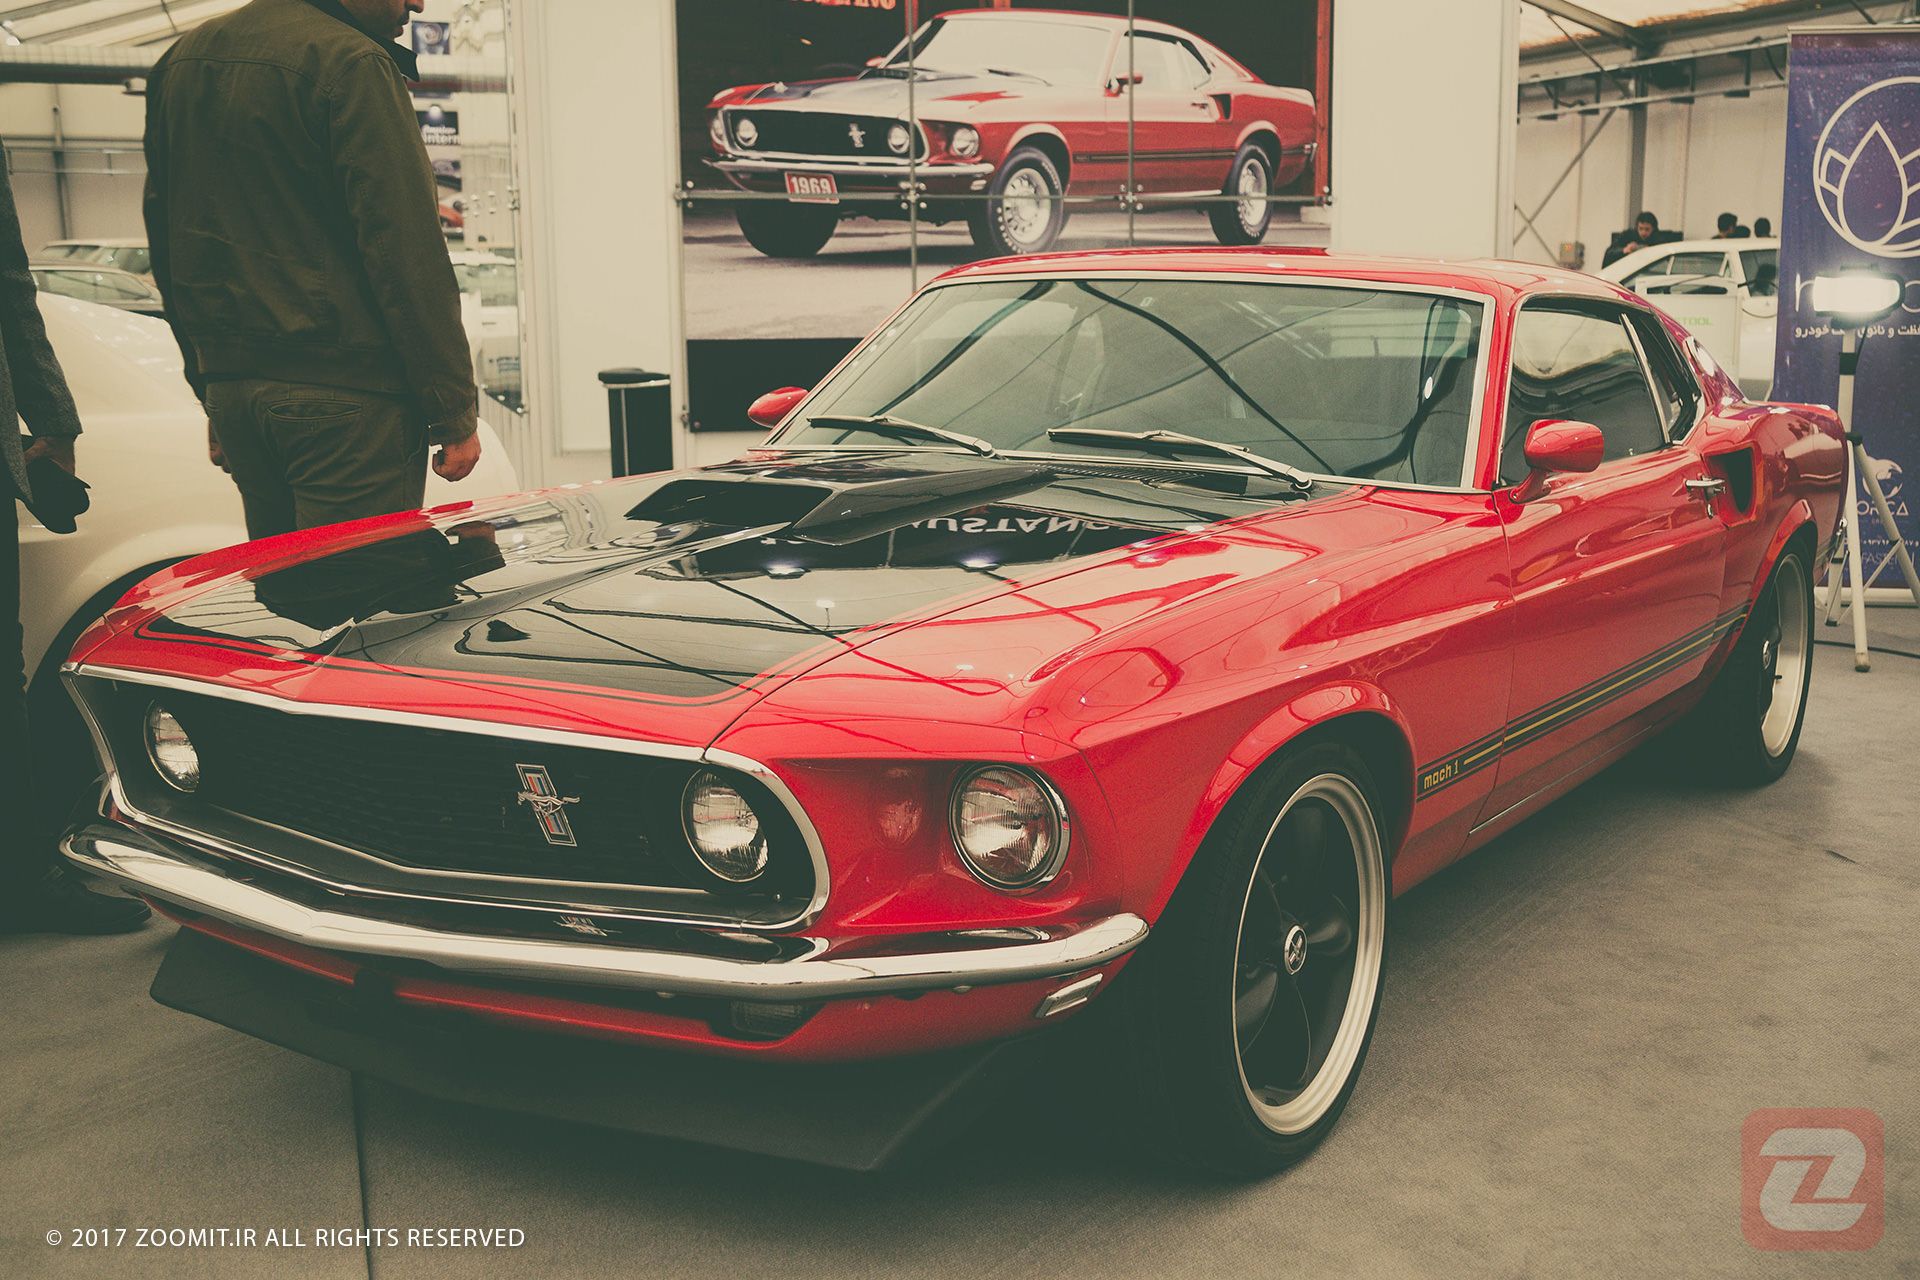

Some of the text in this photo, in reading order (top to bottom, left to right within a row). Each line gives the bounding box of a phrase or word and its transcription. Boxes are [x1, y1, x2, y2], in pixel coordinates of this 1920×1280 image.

[791, 176, 833, 195] 1969
[1424, 759, 1459, 790] mach 1
